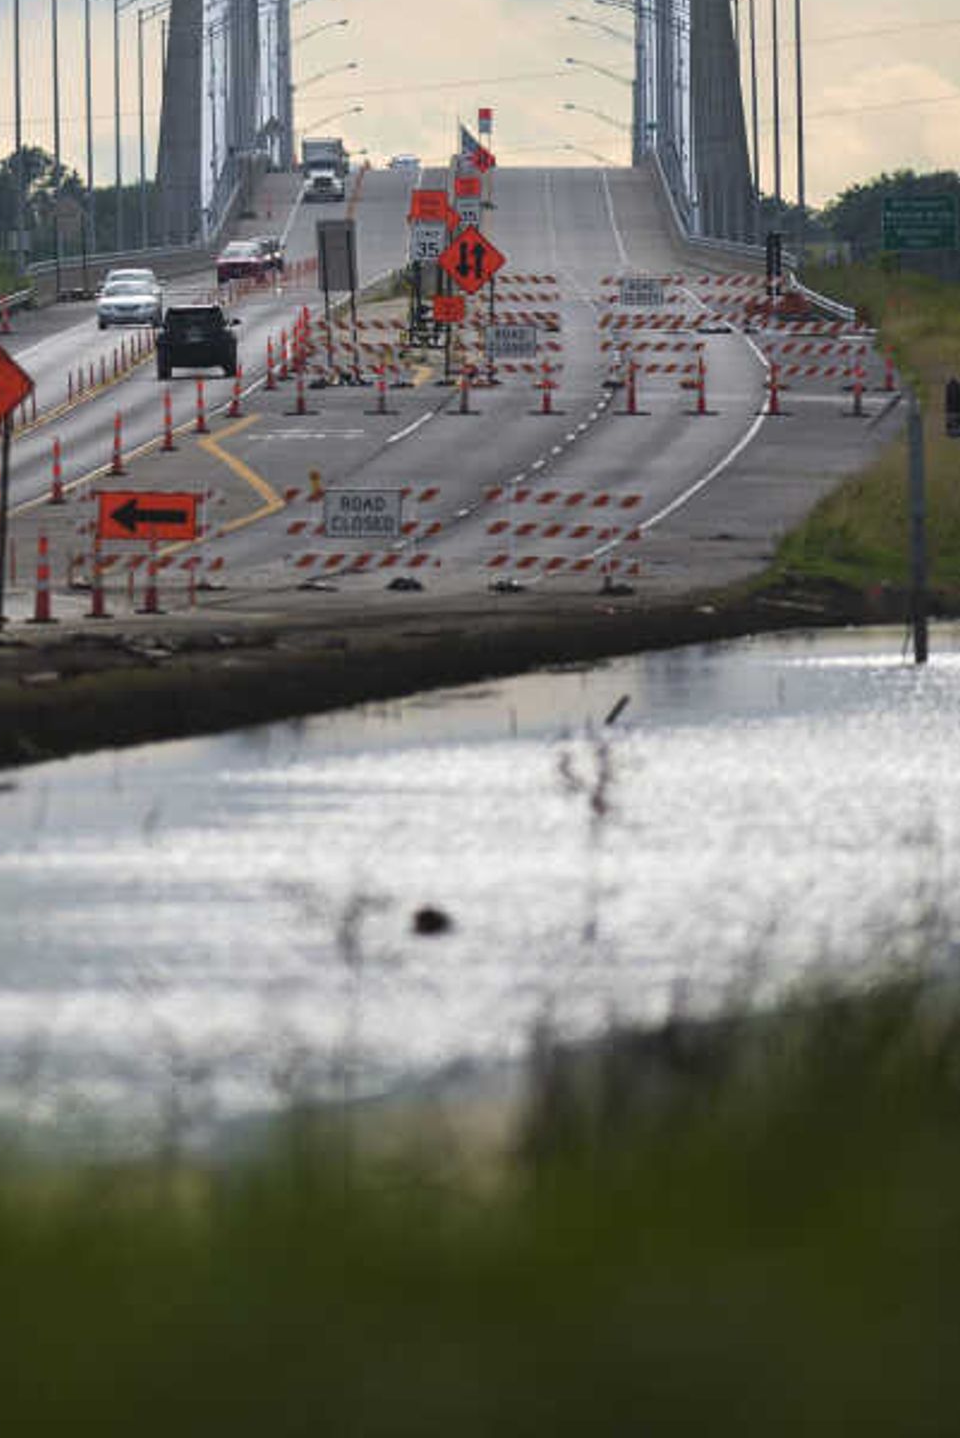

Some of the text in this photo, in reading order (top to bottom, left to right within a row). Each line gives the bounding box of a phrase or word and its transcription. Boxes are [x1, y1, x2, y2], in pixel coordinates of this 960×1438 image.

[416, 242, 440, 258] 35
[341, 496, 386, 512] ROAD
[331, 515, 396, 532] CLOSED
